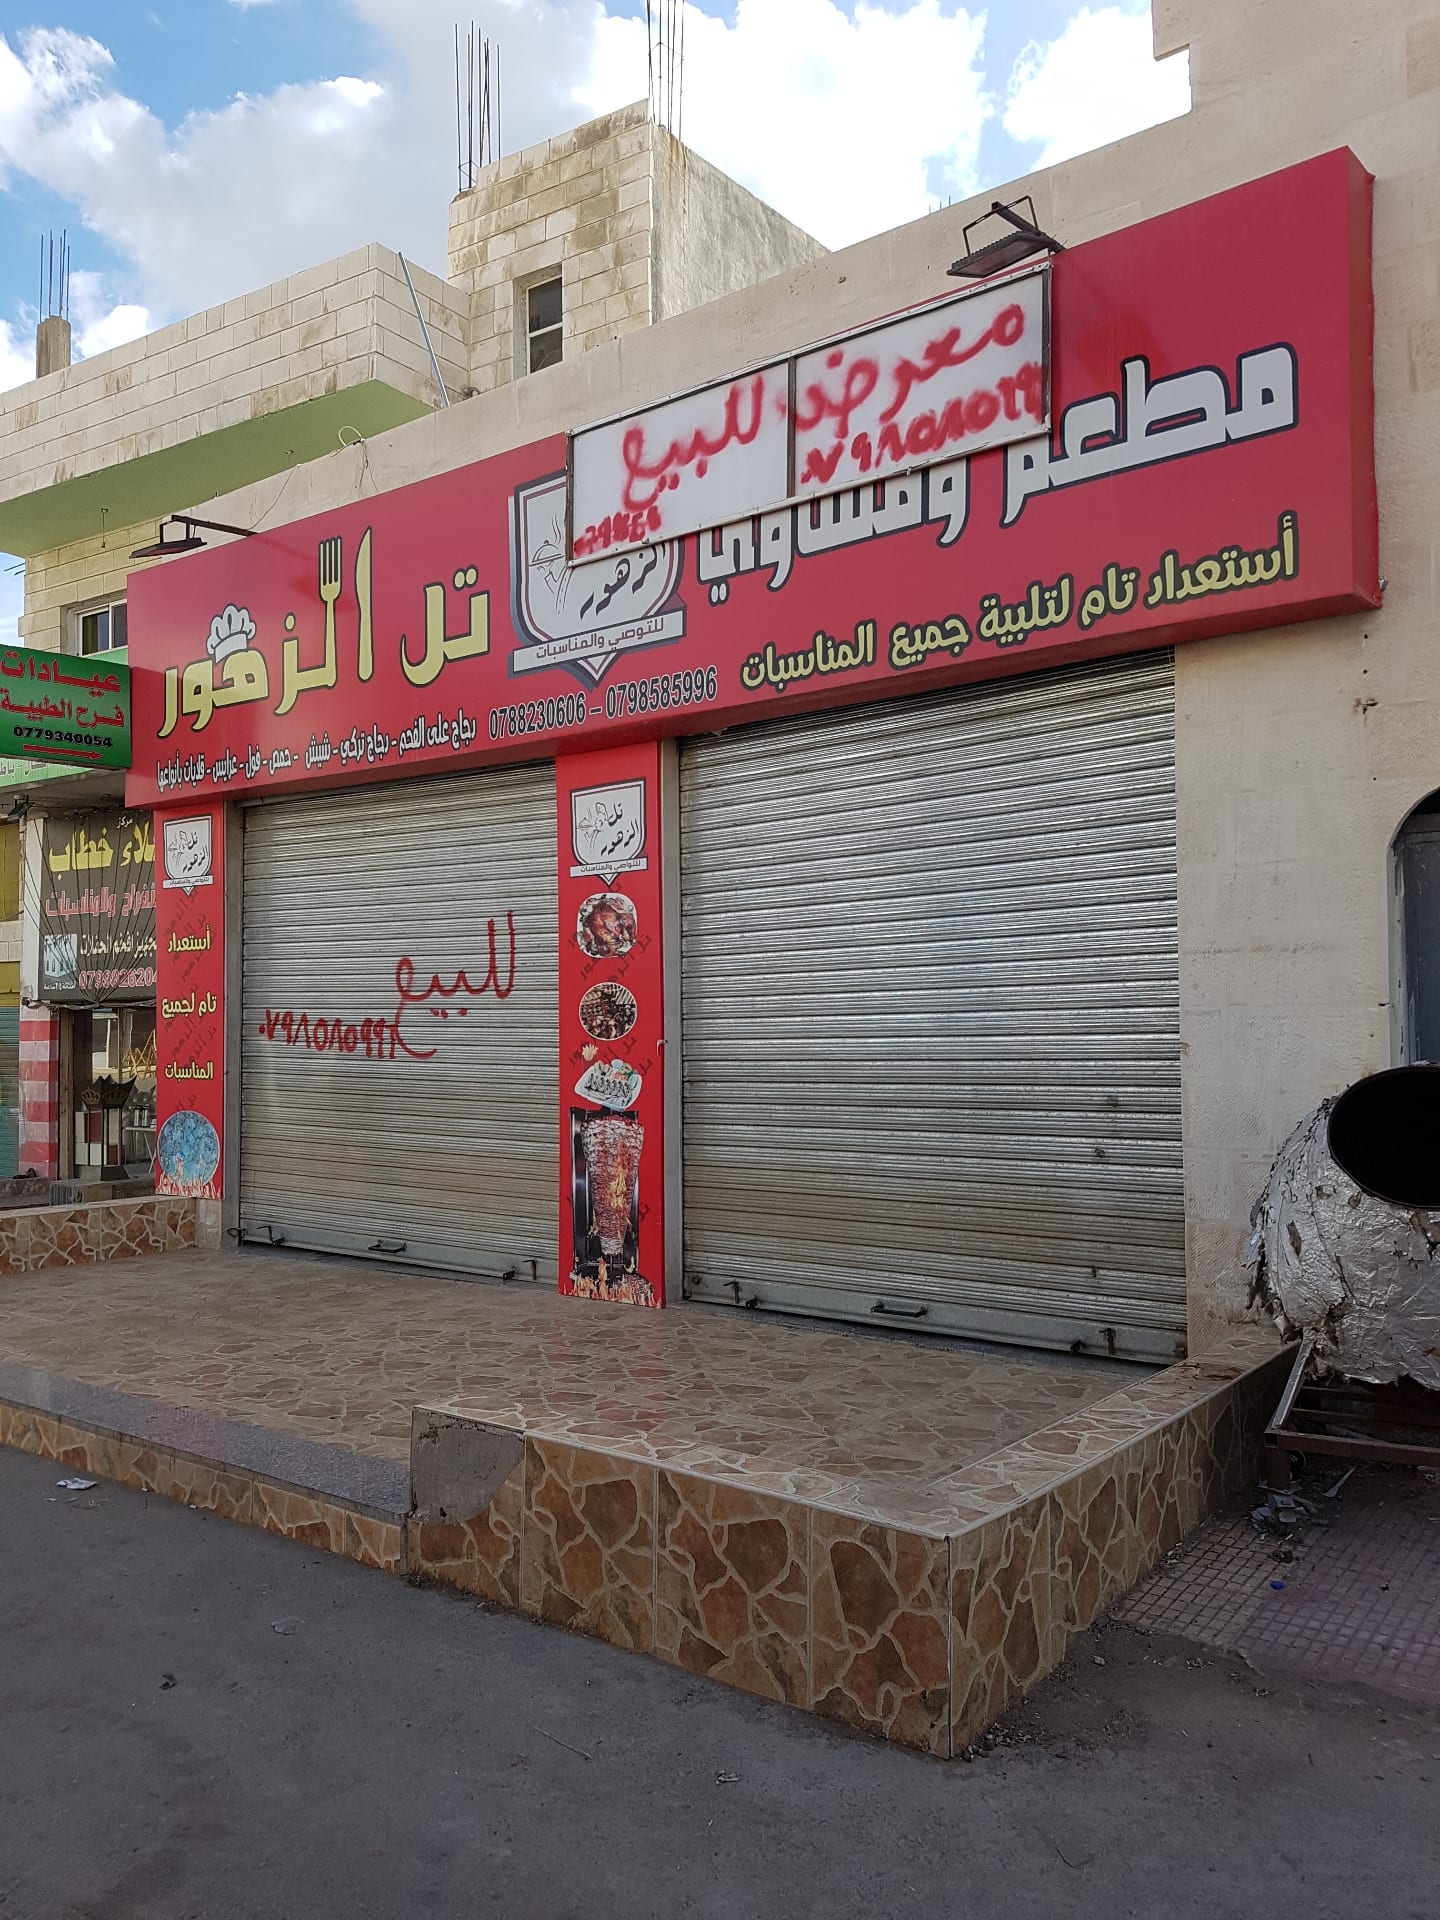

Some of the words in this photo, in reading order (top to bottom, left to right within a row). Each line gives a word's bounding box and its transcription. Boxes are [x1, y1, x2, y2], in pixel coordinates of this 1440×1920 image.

[780, 303, 1025, 439] معرض
[623, 374, 764, 511] للبيع
[1000, 343, 1296, 527] مطعم
[979, 577, 1071, 644] لتلبية
[1080, 565, 1138, 627] تام
[157, 526, 375, 737] الزهور
[400, 566, 491, 689] تل
[536, 633, 605, 660] والمناسبات
[890, 617, 969, 667] جميع
[0, 650, 121, 697] عيادات
[741, 622, 875, 690] المناسبات
[0, 687, 73, 722] الطبية
[76, 704, 125, 728] فرح
[488, 691, 586, 742] 0788230606
[606, 666, 718, 719] 0798585996
[13, 725, 113, 748] 0779340054
[399, 716, 425, 756] الفحم
[245, 743, 261, 778] فول
[269, 748, 292, 776] حمص
[49, 827, 114, 881] خطاب
[120, 821, 156, 867] لاء
[161, 992, 195, 1018] لجميع
[198, 992, 217, 1017] تام
[395, 910, 516, 1059] للبيع
[165, 1060, 214, 1083] المناسبات
